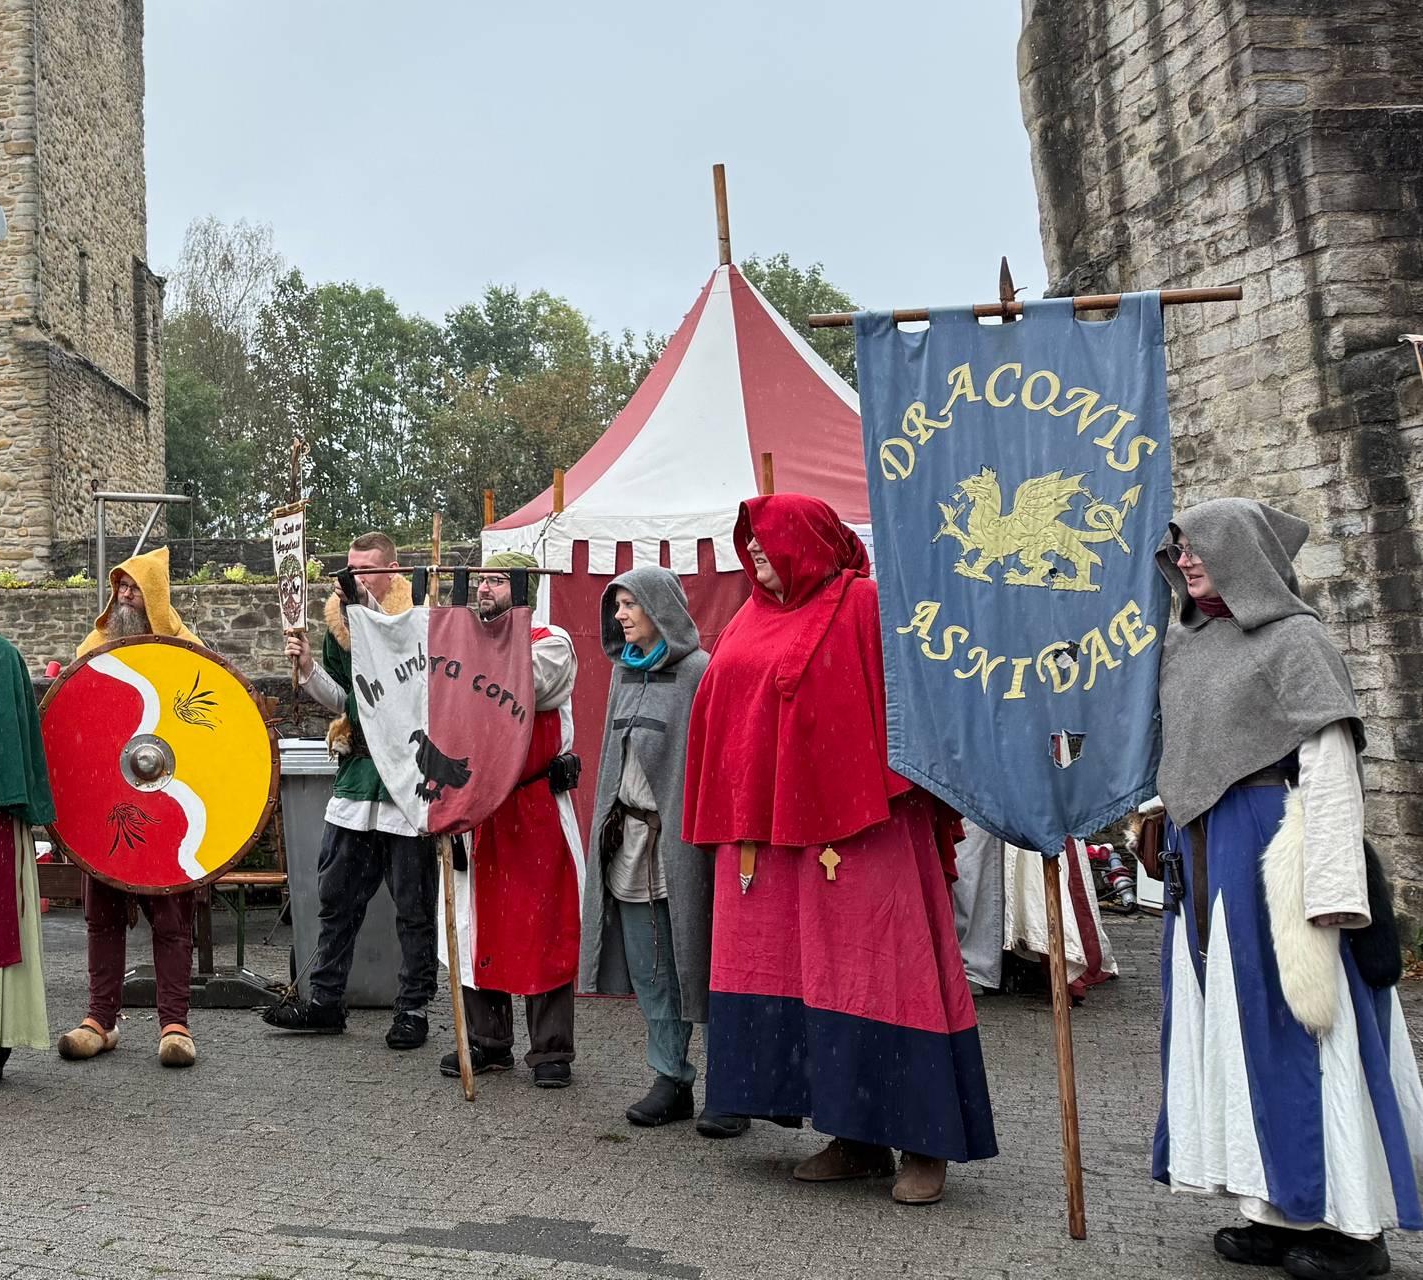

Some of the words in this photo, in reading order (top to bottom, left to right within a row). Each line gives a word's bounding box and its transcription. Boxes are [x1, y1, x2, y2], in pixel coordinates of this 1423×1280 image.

[879, 362, 1159, 481] DRACONIS
[355, 673, 385, 708] In
[394, 641, 462, 684] umbra
[472, 674, 526, 725] corvi
[896, 599, 1157, 700] ASNIDAE
